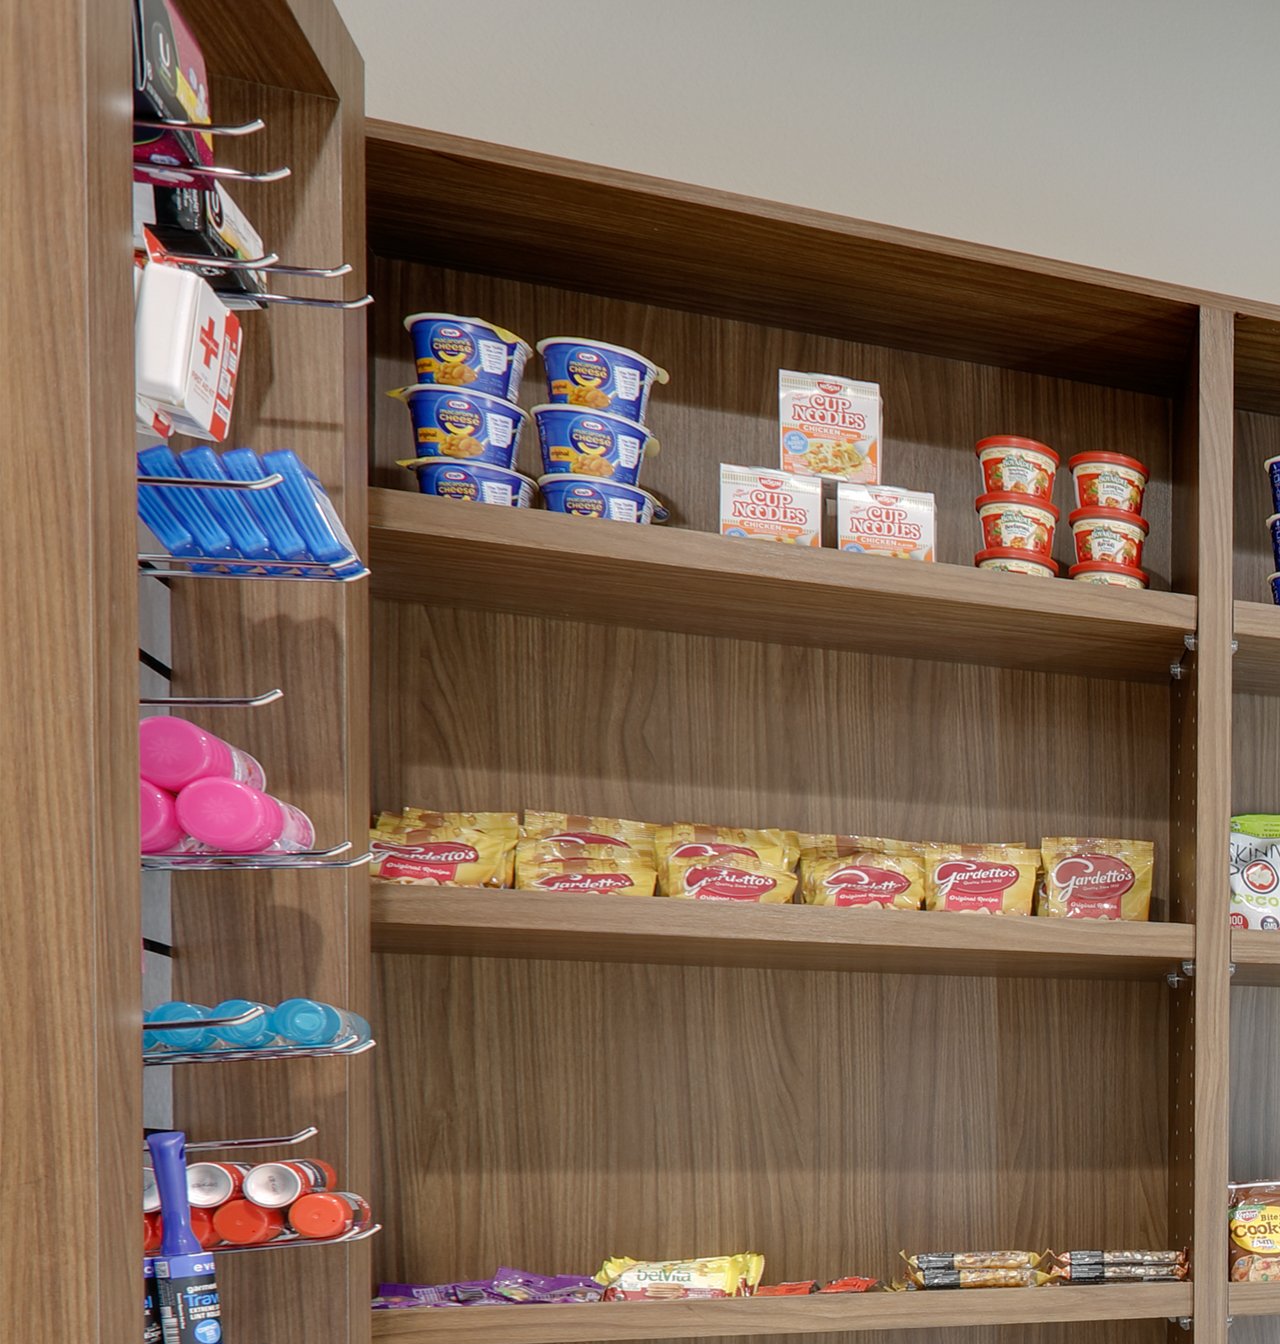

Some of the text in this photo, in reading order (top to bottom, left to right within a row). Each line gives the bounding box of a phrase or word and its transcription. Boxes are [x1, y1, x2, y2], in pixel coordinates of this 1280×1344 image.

[810, 395, 851, 411] CUP
[792, 405, 865, 430] NOODLES
[803, 425, 841, 436] CHICKEN
[751, 490, 793, 507] CUP
[733, 501, 807, 525] NOODLES
[867, 506, 907, 522] CUP
[743, 521, 782, 531] CHICKEN
[850, 517, 921, 540] NOODLES
[860, 537, 897, 546] CHICKEN
[385, 862, 451, 876] Original Recipe
[1052, 854, 1133, 899] Gardetto's
[936, 860, 1019, 897] Gardetto's
[949, 894, 976, 903] Original
[1071, 901, 1097, 909] Original
[1260, 1212, 1277, 1222] Bite
